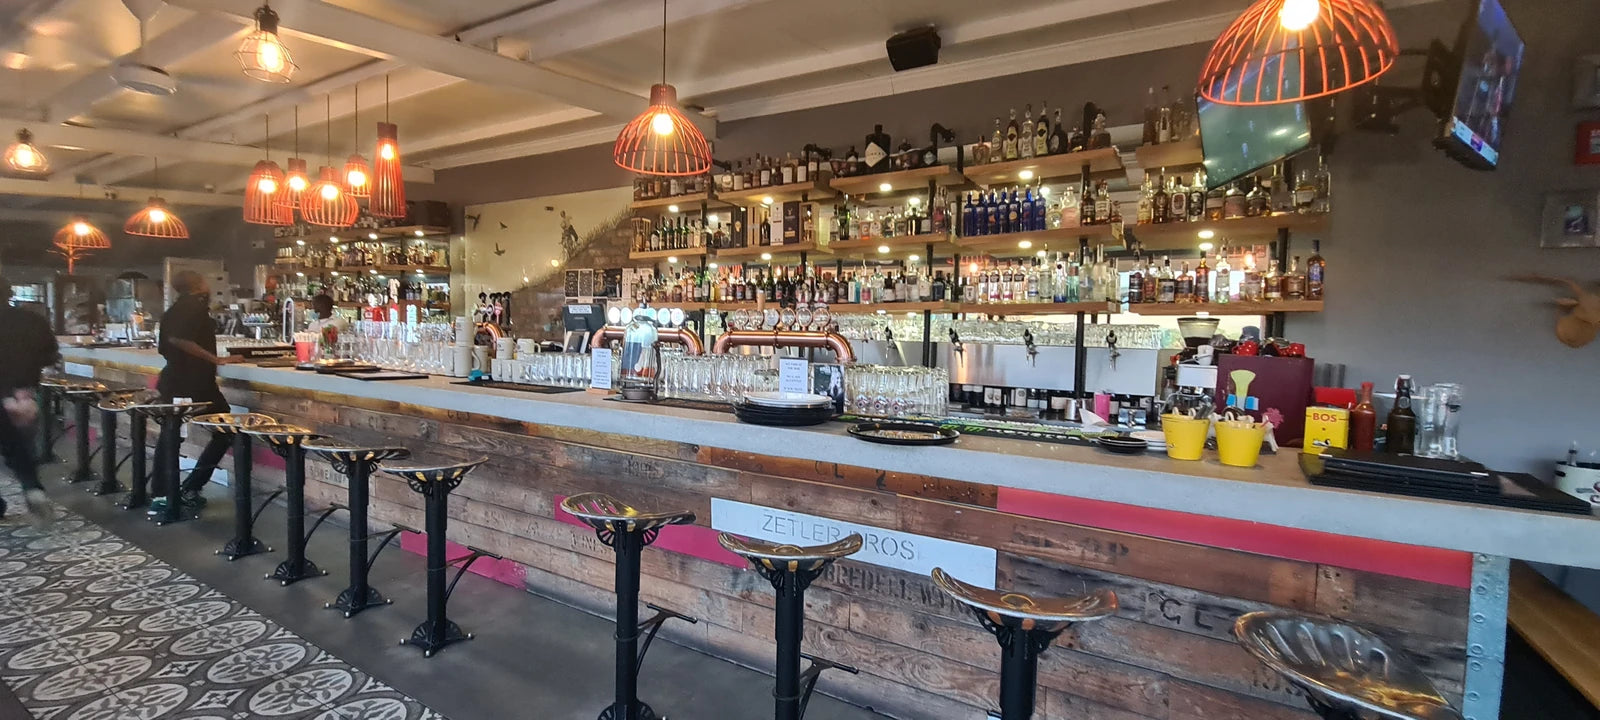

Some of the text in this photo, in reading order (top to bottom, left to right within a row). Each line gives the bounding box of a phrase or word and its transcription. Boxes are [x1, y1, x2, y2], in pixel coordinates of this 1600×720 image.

[1312, 413, 1337, 423] BOS
[761, 513, 915, 560] ZETLER ROS
